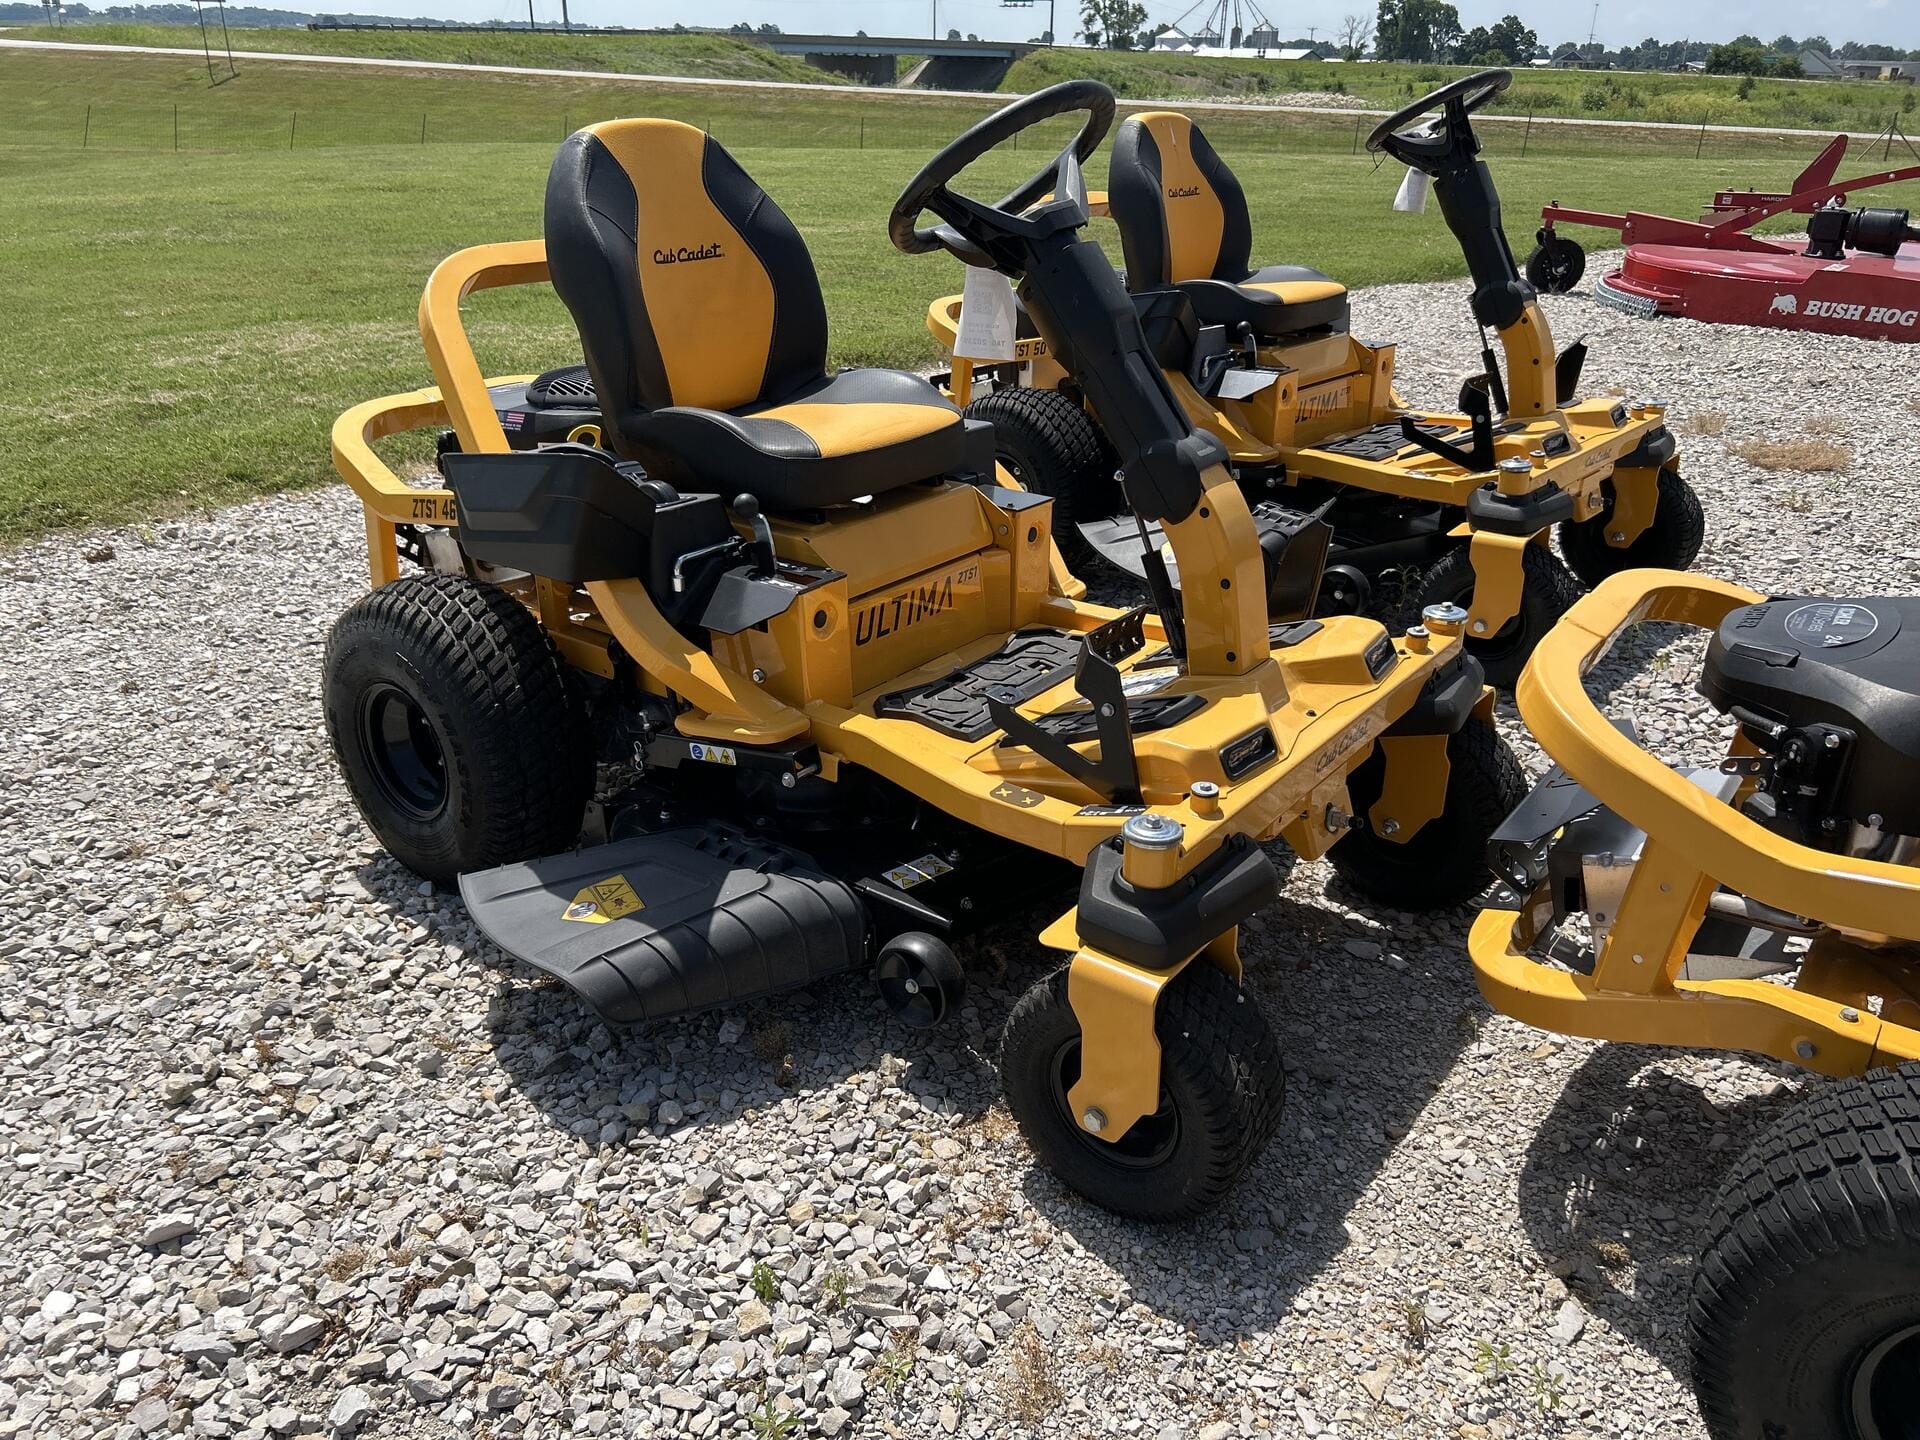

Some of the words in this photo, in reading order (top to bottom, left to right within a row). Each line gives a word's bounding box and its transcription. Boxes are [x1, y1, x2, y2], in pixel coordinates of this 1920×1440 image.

[653, 248, 676, 264] Cub
[677, 243, 721, 262] Cadet
[1803, 300, 1866, 321] BUSH
[1864, 306, 1919, 327] HOG
[1033, 341, 1046, 356] 50
[412, 498, 437, 519] ZTS1
[441, 499, 456, 521] 46
[855, 575, 953, 647] ULTIMA
[957, 566, 978, 584] ZTS1
